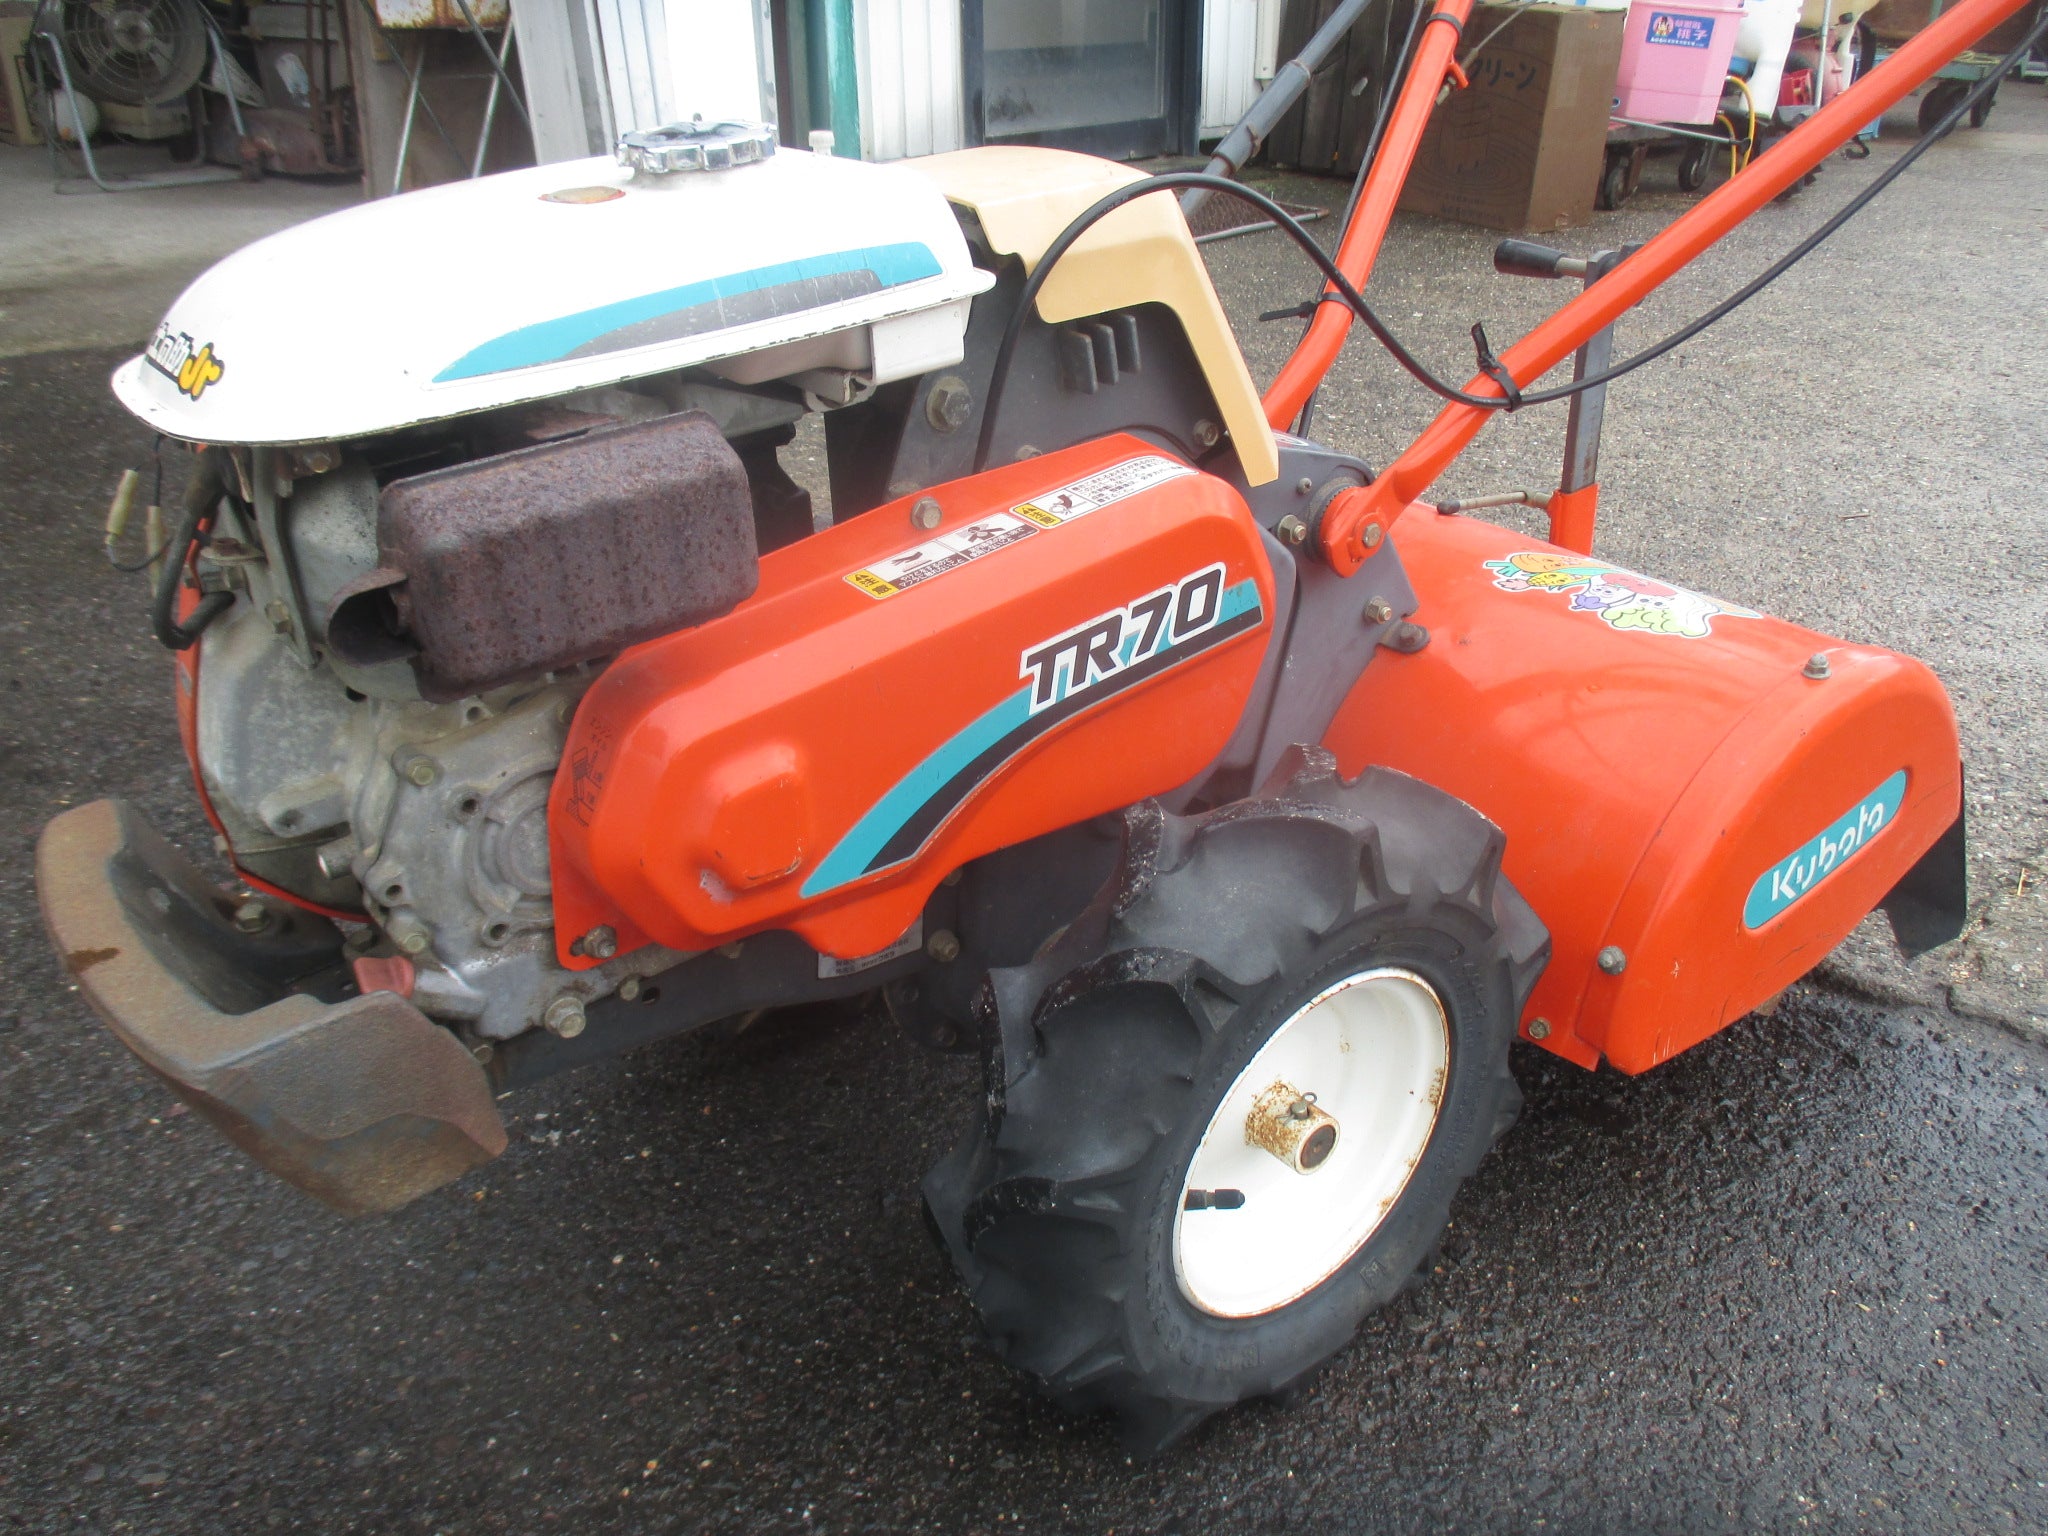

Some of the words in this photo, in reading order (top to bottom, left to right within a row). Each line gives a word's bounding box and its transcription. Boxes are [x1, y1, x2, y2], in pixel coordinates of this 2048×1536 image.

[1030, 512, 1054, 525] 注意
[861, 576, 891, 595] 注意
[1023, 565, 1224, 708] TR70
[1771, 802, 1884, 902] Kubota
